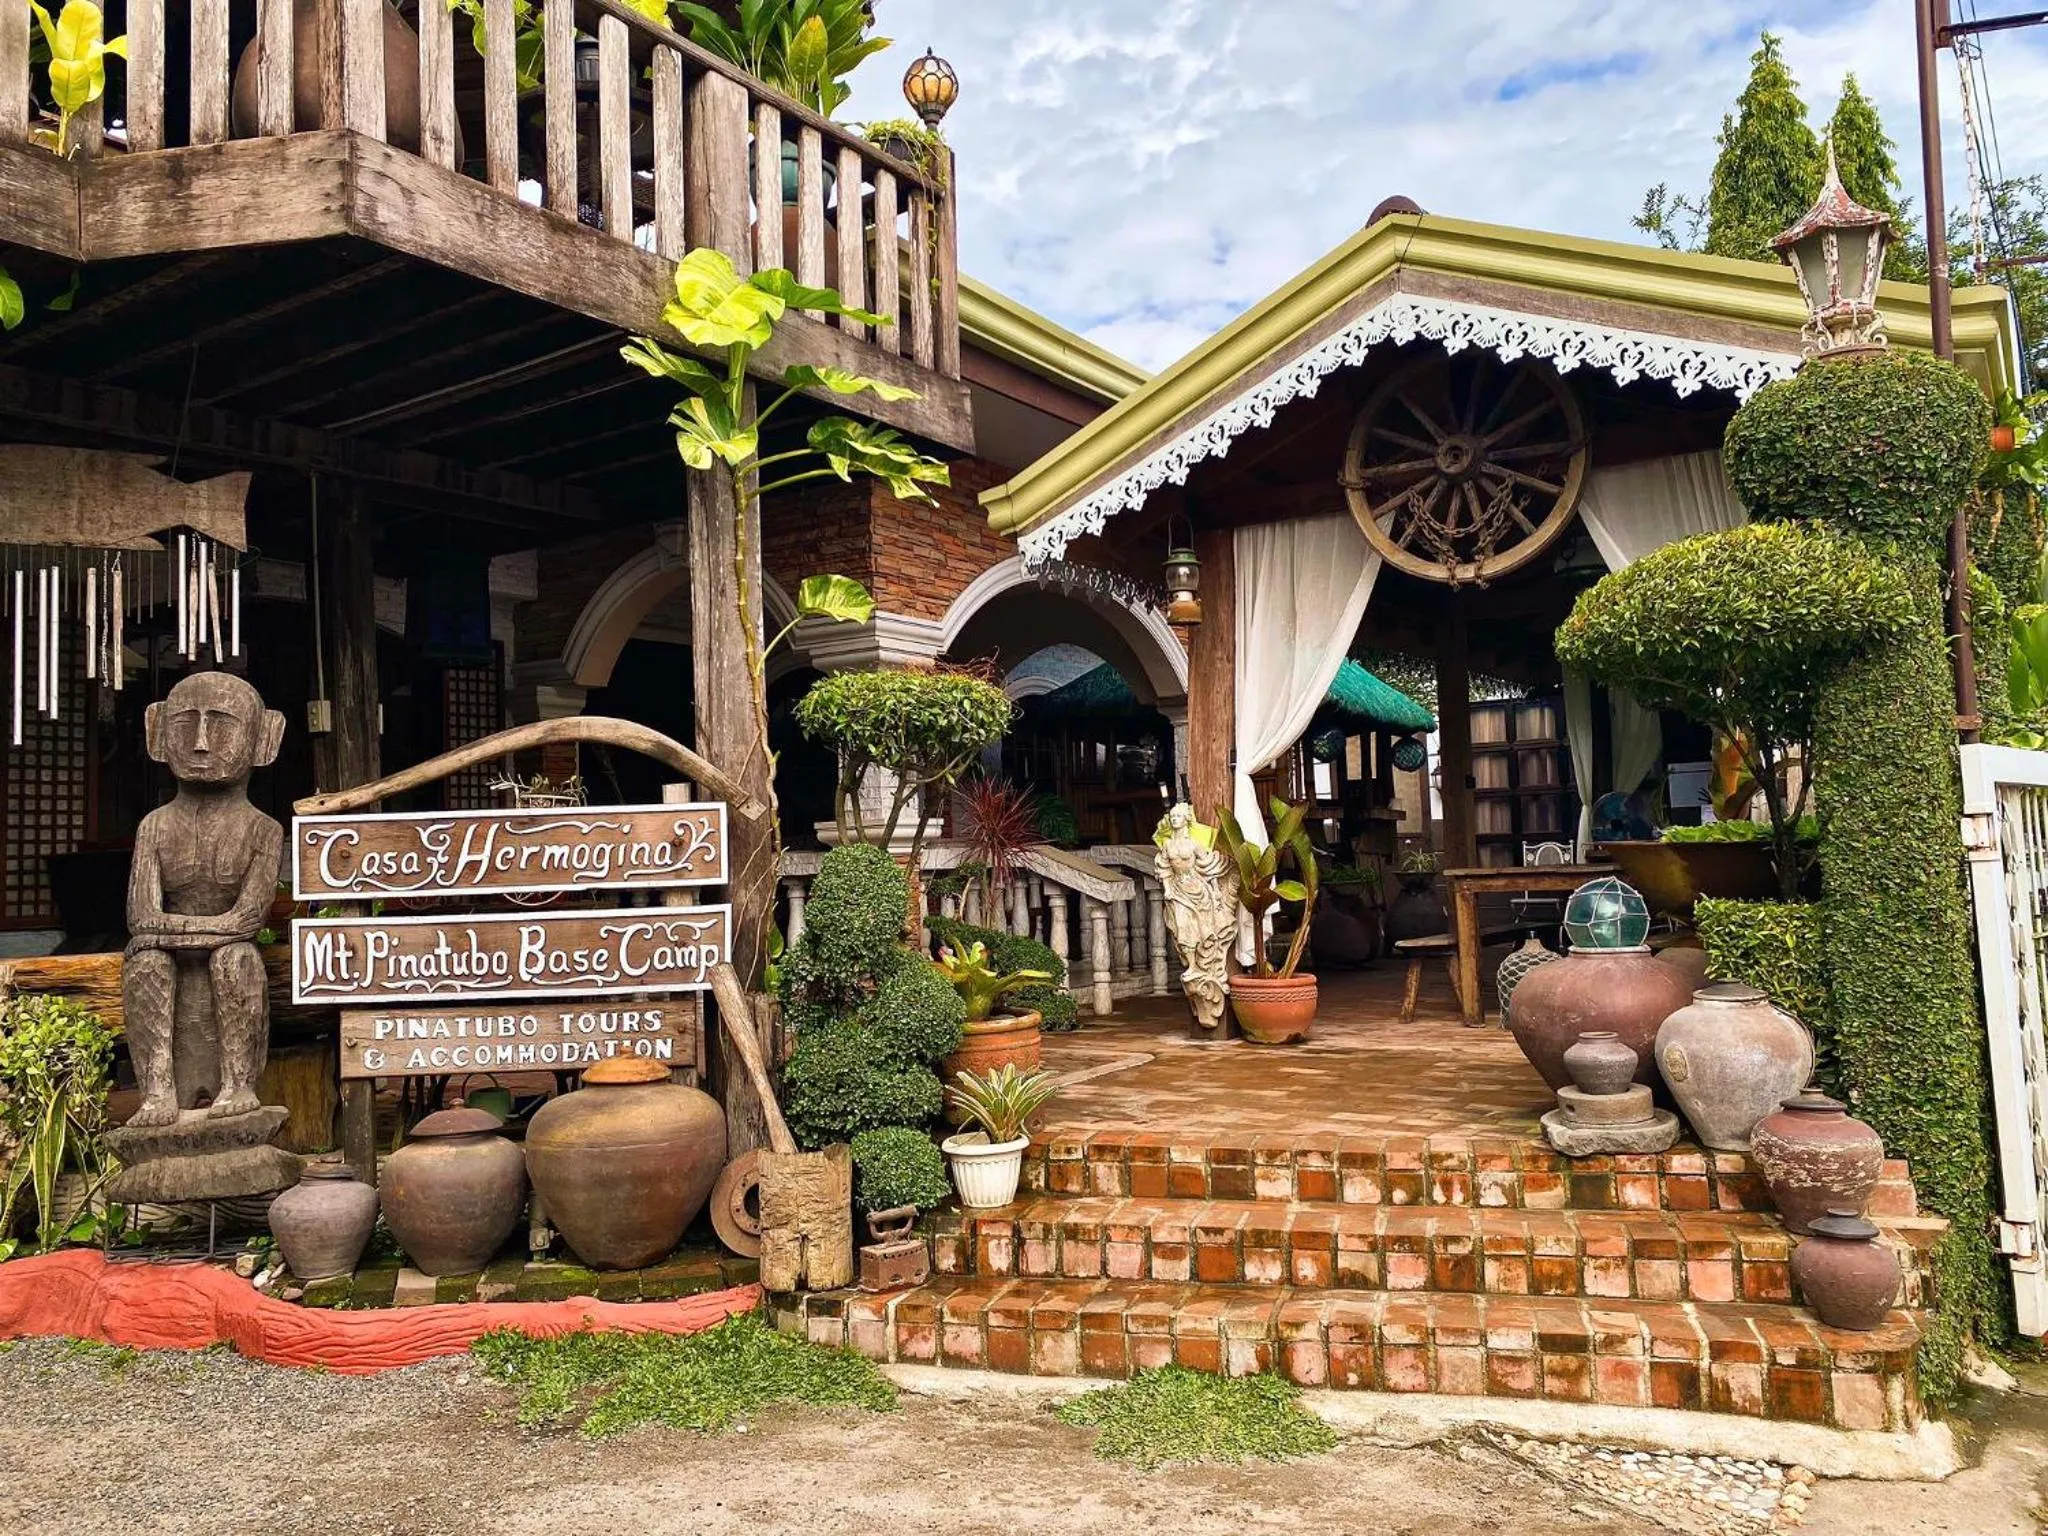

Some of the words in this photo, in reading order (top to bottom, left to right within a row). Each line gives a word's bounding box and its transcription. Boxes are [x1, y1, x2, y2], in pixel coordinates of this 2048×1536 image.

[304, 828, 422, 888] Casa
[436, 821, 674, 884] Hermogina
[299, 931, 361, 988] Mt.
[360, 928, 509, 988] Pinatubo
[518, 925, 610, 982] Base
[600, 922, 720, 983] Camp
[374, 1015, 538, 1040] PINATUBO
[558, 1010, 662, 1034] TOURS
[363, 1049, 385, 1069] &
